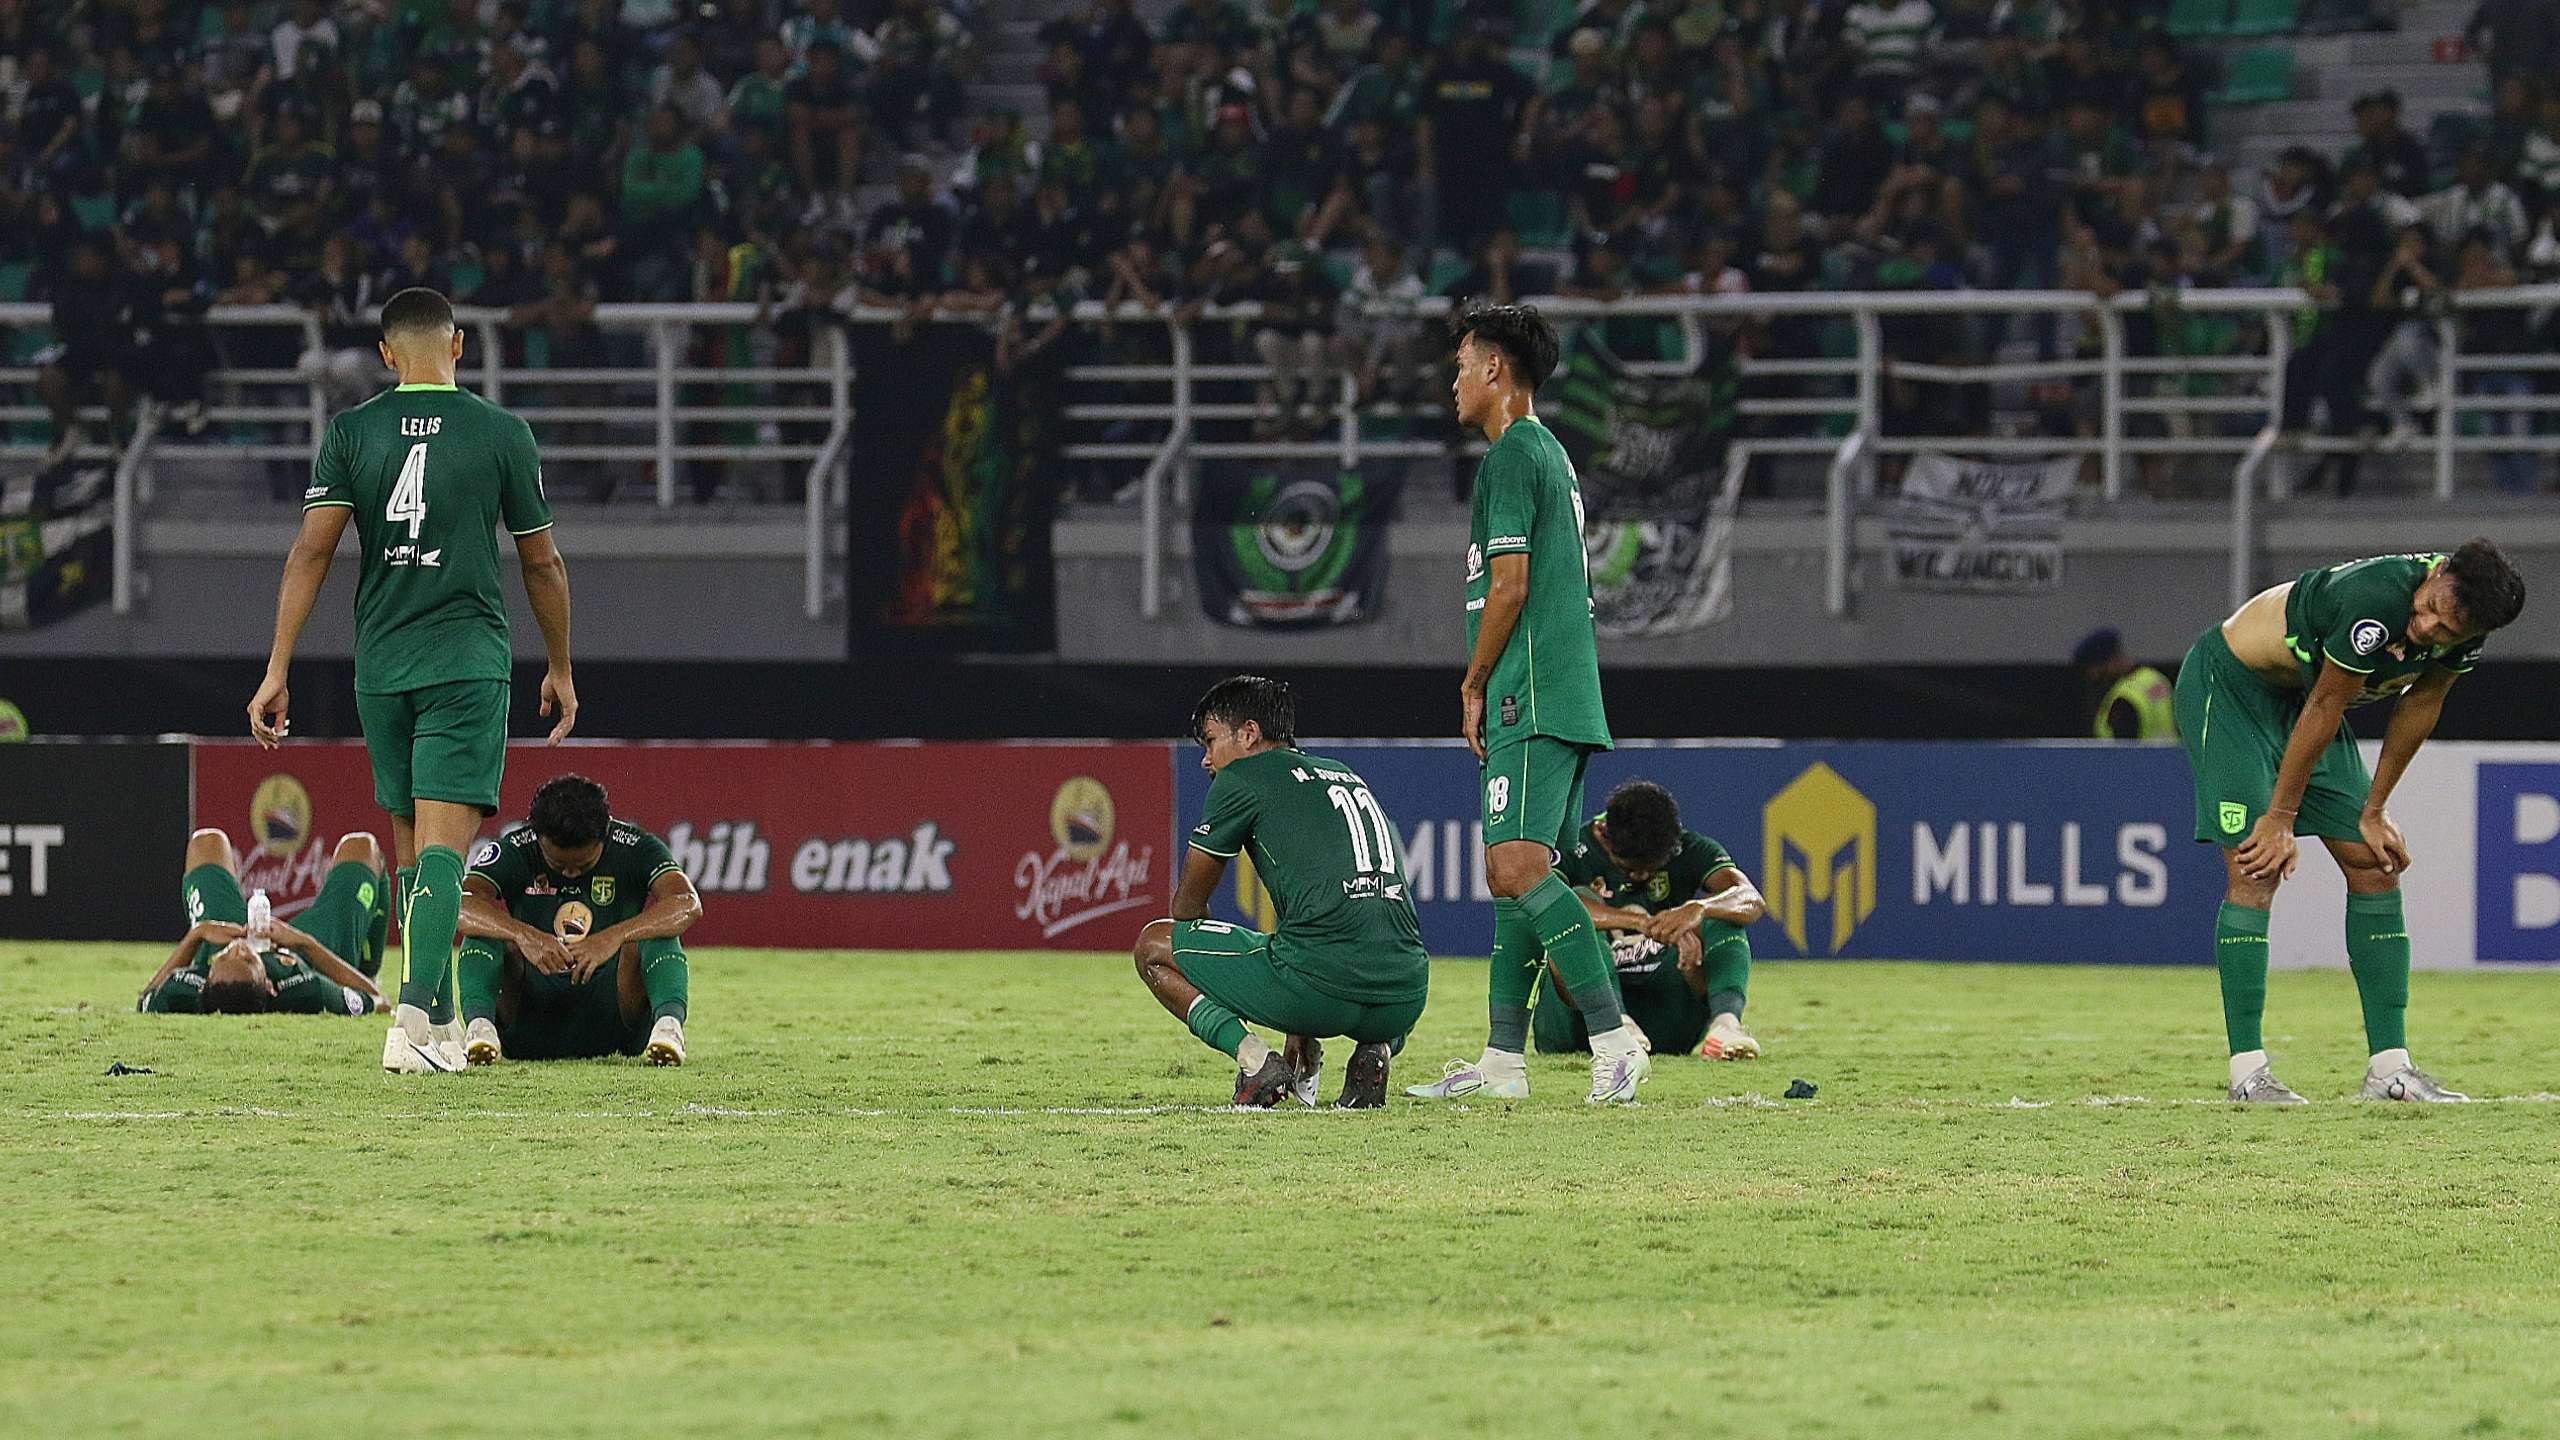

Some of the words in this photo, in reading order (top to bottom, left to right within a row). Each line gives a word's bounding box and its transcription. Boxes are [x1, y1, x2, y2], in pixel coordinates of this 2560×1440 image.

[401, 416, 442, 436] LELIS
[386, 442, 428, 539] 4
[1326, 784, 1396, 875] 11
[1487, 775, 1510, 814] 18
[0, 823, 66, 896] T
[791, 820, 955, 891] enak
[1342, 876, 1379, 893] MPM
[1912, 820, 2168, 906] MILLS
